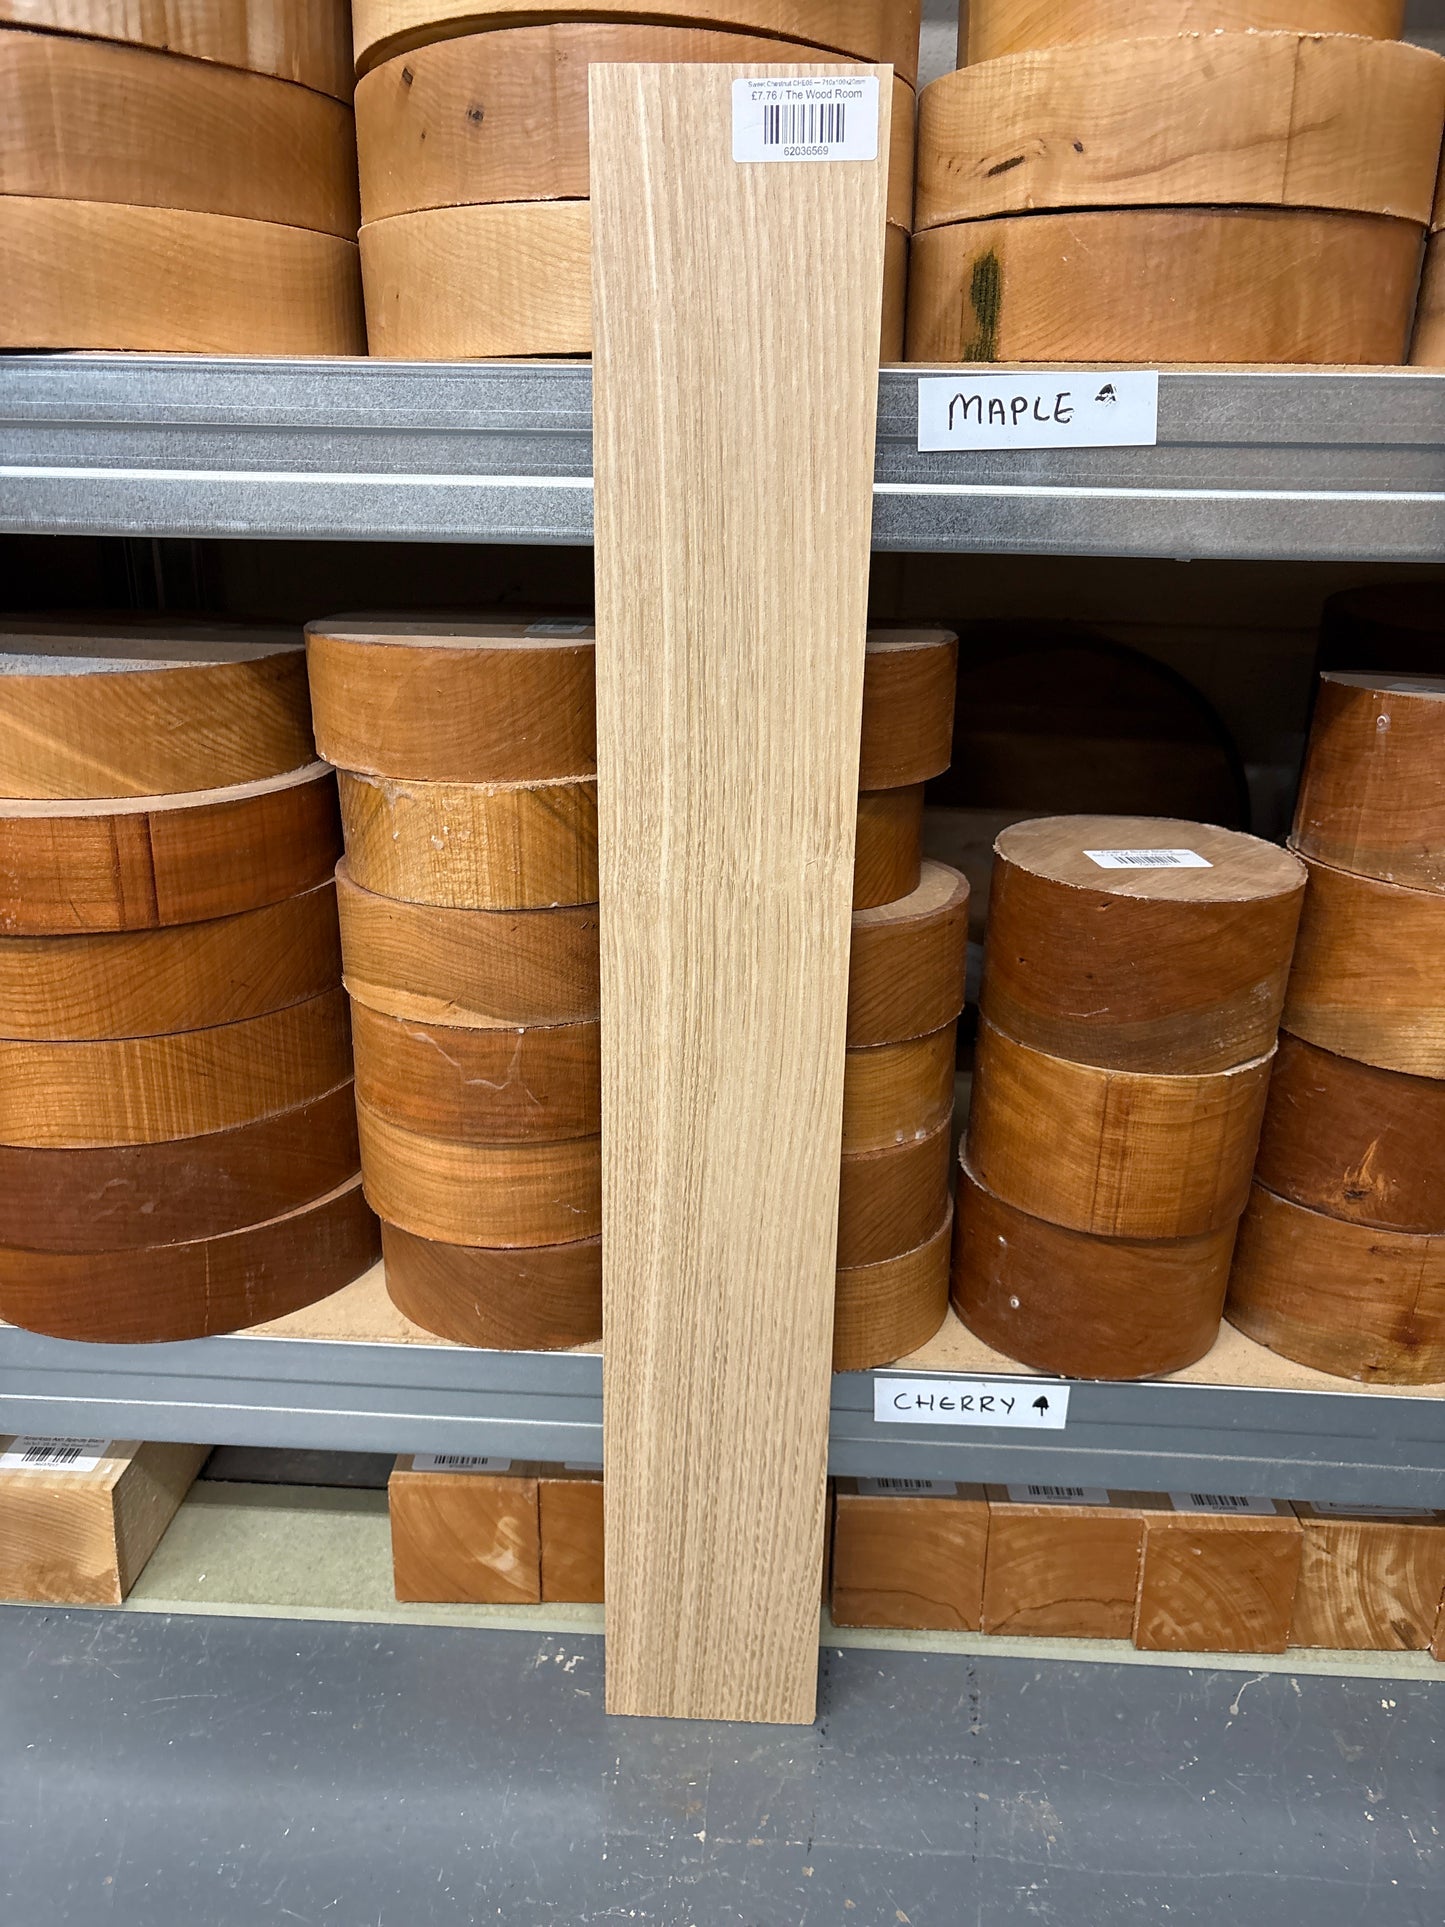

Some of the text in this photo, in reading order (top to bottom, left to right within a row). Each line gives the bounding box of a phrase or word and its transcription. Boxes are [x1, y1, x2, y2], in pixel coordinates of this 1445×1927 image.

[751, 88, 863, 101] £7.76 / The Wood Room
[783, 145, 829, 156] 62036569
[948, 392, 1074, 431] MAPLE
[893, 1392, 1015, 1415] CHERRY
